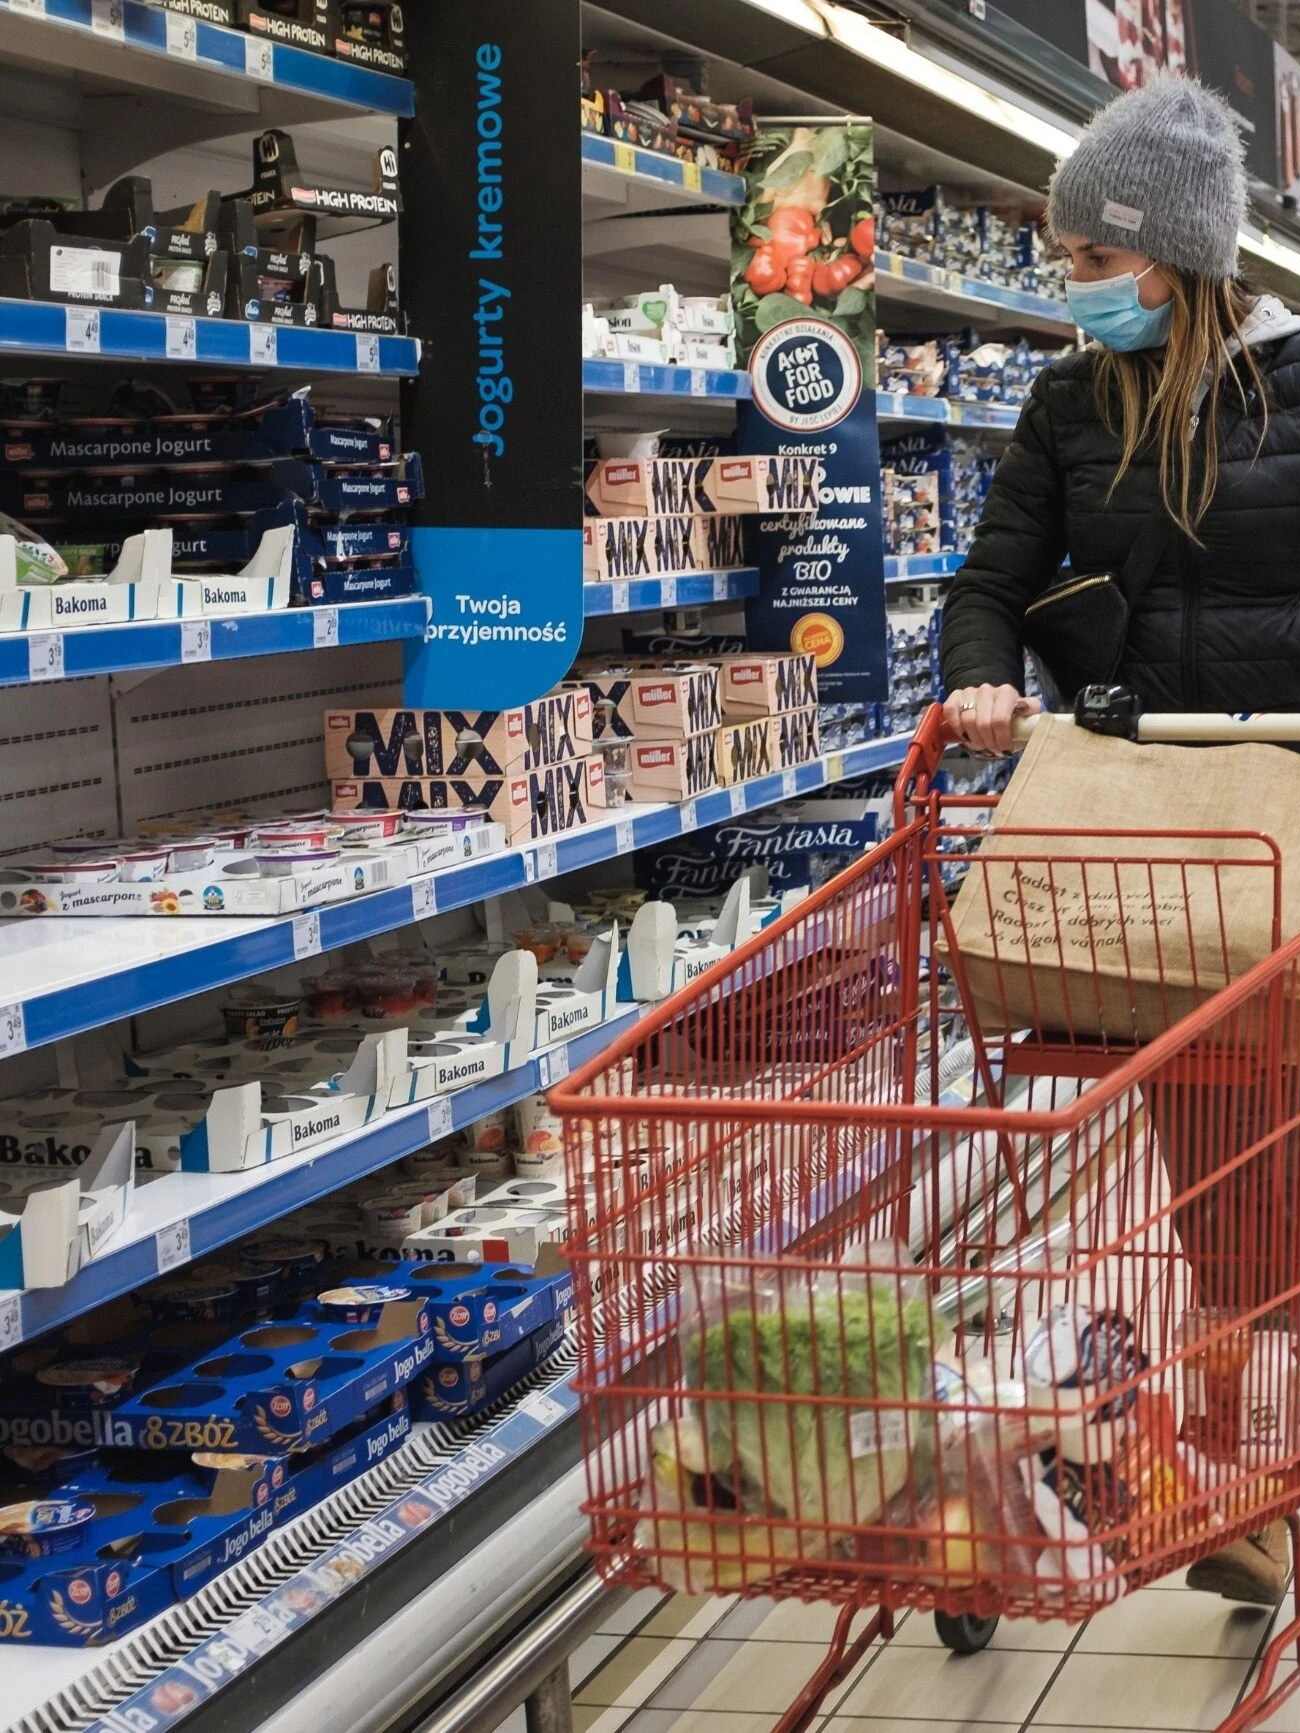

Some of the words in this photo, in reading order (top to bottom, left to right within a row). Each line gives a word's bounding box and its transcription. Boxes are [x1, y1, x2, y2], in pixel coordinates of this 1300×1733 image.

[191, 1, 229, 22] PROTEIN
[267, 17, 290, 36] HIGH
[291, 23, 326, 46] PROTEIN
[350, 42, 372, 60] HIGH
[373, 47, 404, 68] PROTEIN
[470, 45, 503, 259] kremowe
[316, 190, 349, 208] HIGH
[350, 194, 397, 212] PROTEIN
[348, 314, 367, 328] HIGH
[368, 315, 396, 330] PROTEIN
[473, 280, 511, 456] Jogurty
[785, 363, 823, 388] FOR
[785, 379, 834, 408] FOOD
[50, 440, 151, 458] Mascarpone
[155, 437, 212, 456] Jogurt
[330, 435, 354, 448] Mascarpone
[354, 437, 368, 450] Jogurt
[778, 443, 827, 455] Konkret
[829, 443, 837, 455] 9
[342, 483, 369, 495] Mascarpone
[370, 483, 385, 495] Jogurt
[652, 461, 694, 514] MIX
[768, 457, 818, 509] MIX
[819, 486, 871, 504] OWIE
[68, 489, 164, 508] Mascarpone
[167, 487, 222, 506] Jogurt
[760, 512, 868, 539] certyfikowane
[172, 540, 207, 556] gurt
[606, 520, 650, 577] MIX
[656, 517, 696, 572] MIX
[777, 534, 849, 563] produkty
[793, 559, 832, 580] BIO
[204, 587, 247, 605] Bakoma
[344, 580, 374, 592] Mascarpone
[374, 578, 391, 591] Jogurt
[781, 587, 789, 596] Z
[790, 585, 852, 596] GWARANCJĄ
[56, 597, 107, 615] Bakoma
[455, 595, 521, 620] Twoja
[772, 596, 831, 609] NAJNIŻSZEJ
[832, 596, 859, 606] CENY
[424, 621, 567, 645] przyjemność
[733, 668, 761, 681] müller
[777, 655, 818, 710] MIX
[642, 690, 673, 702] müller
[688, 669, 721, 733] MIX
[354, 712, 503, 776] MIX
[525, 695, 575, 770] MIX
[780, 709, 820, 767] MIX
[641, 753, 671, 764] müller
[732, 721, 771, 782] MIX
[686, 734, 719, 795] MIX
[530, 762, 586, 839] MIX
[712, 824, 860, 858] Fantasia
[72, 890, 143, 908] mascarpone
[551, 1005, 588, 1032] Bakoma
[439, 1059, 485, 1084] Bakoma
[294, 1112, 340, 1141] Bakoma
[0, 1135, 153, 1168] Bakoa
